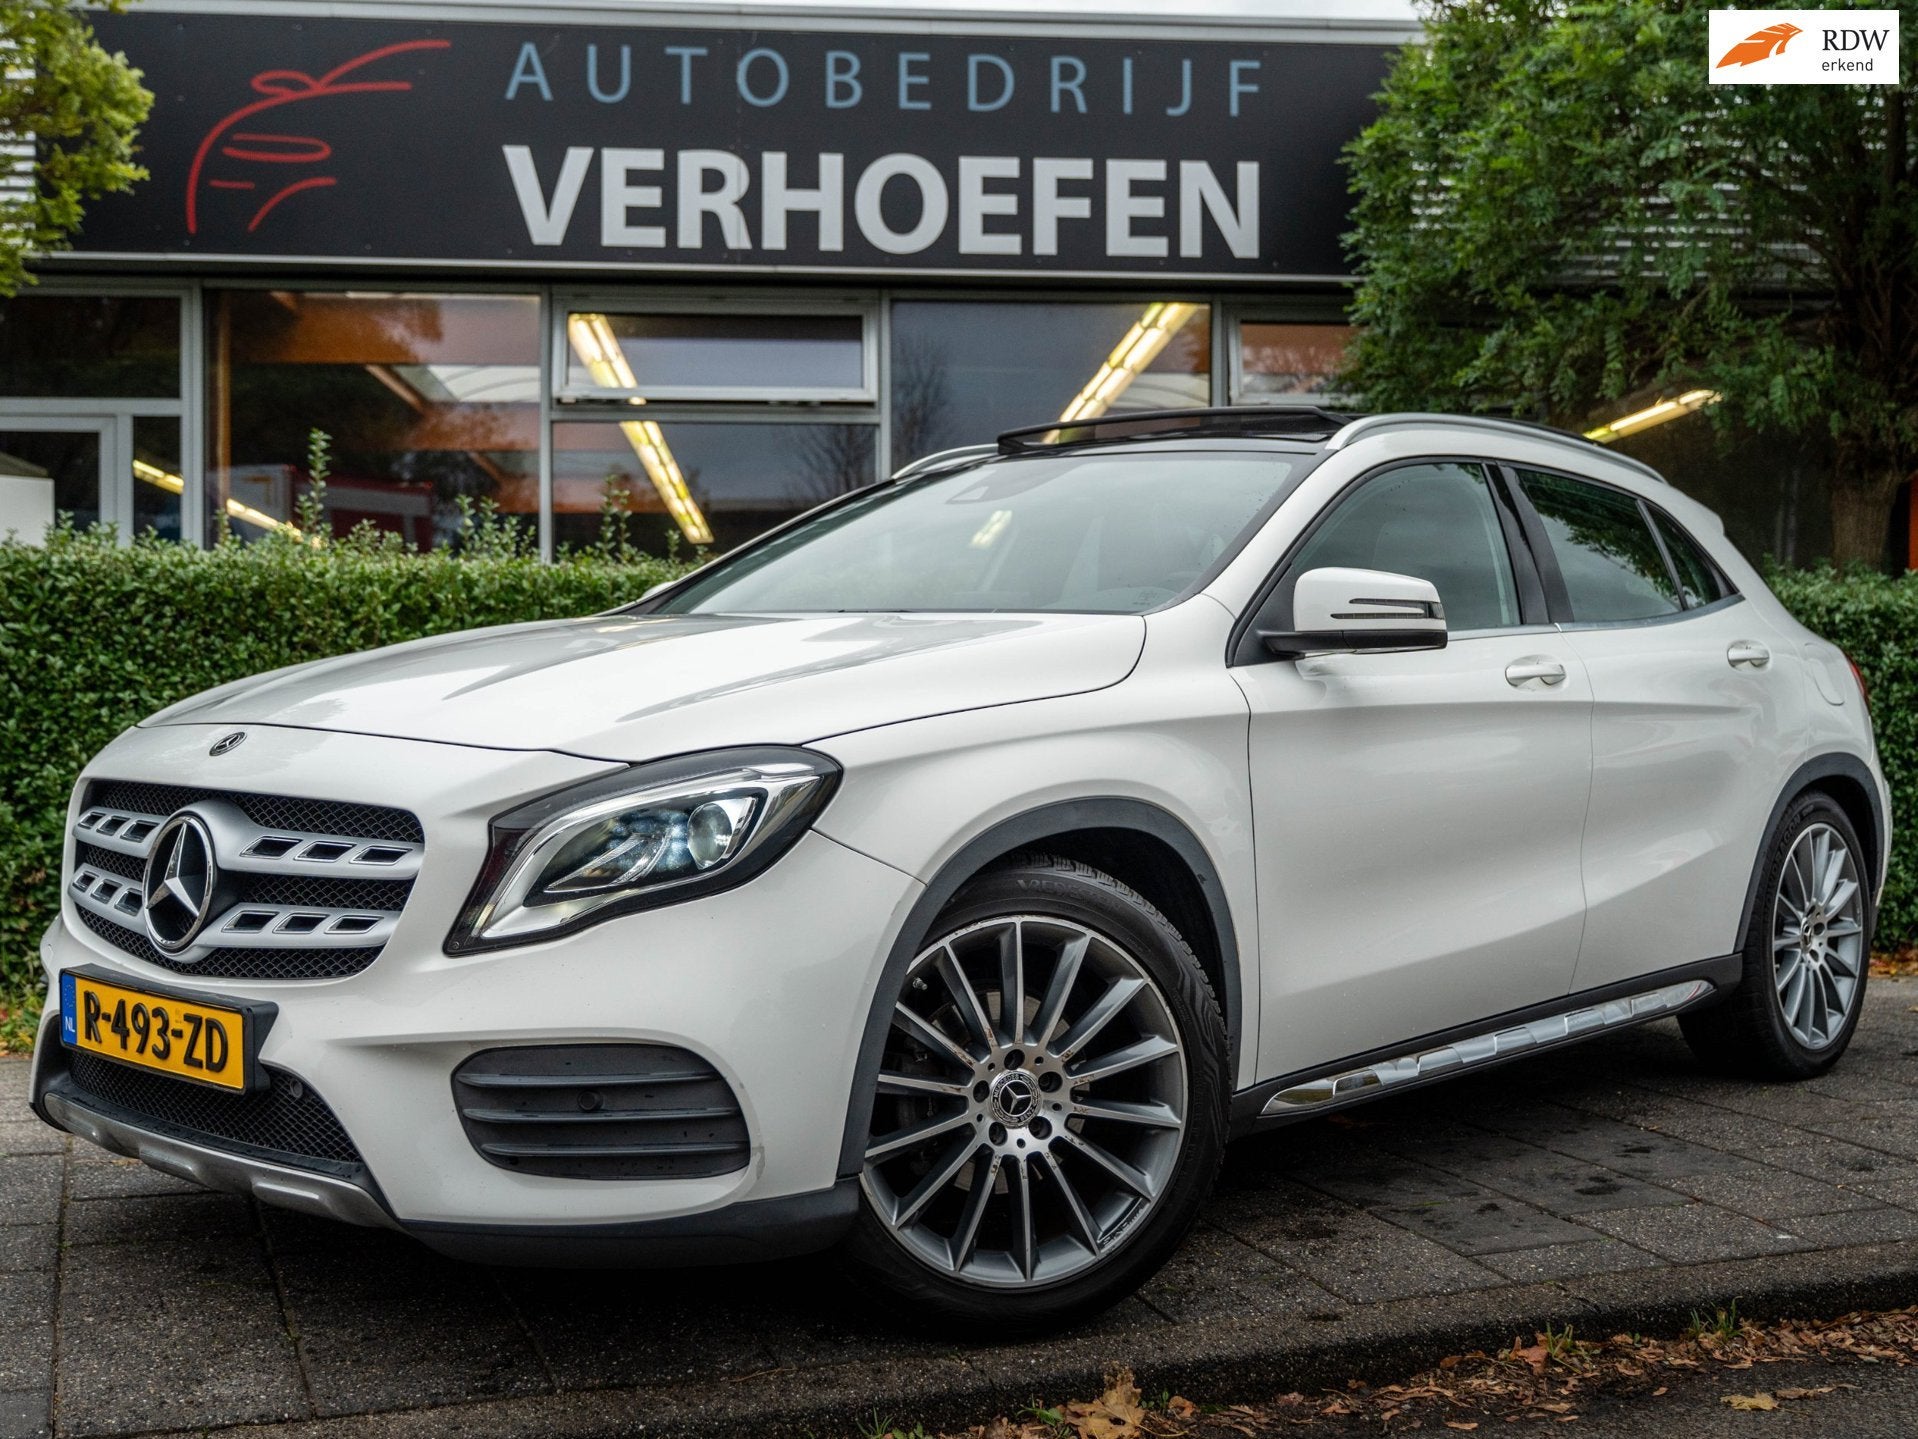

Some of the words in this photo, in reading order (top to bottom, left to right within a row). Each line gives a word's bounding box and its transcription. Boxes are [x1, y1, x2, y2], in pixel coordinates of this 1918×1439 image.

[504, 42, 1261, 117] AUTOBEDRIJF
[502, 145, 1260, 260] VERHOEFEN
[65, 1015, 76, 1034] NL
[83, 990, 229, 1073] R-493-ZD
